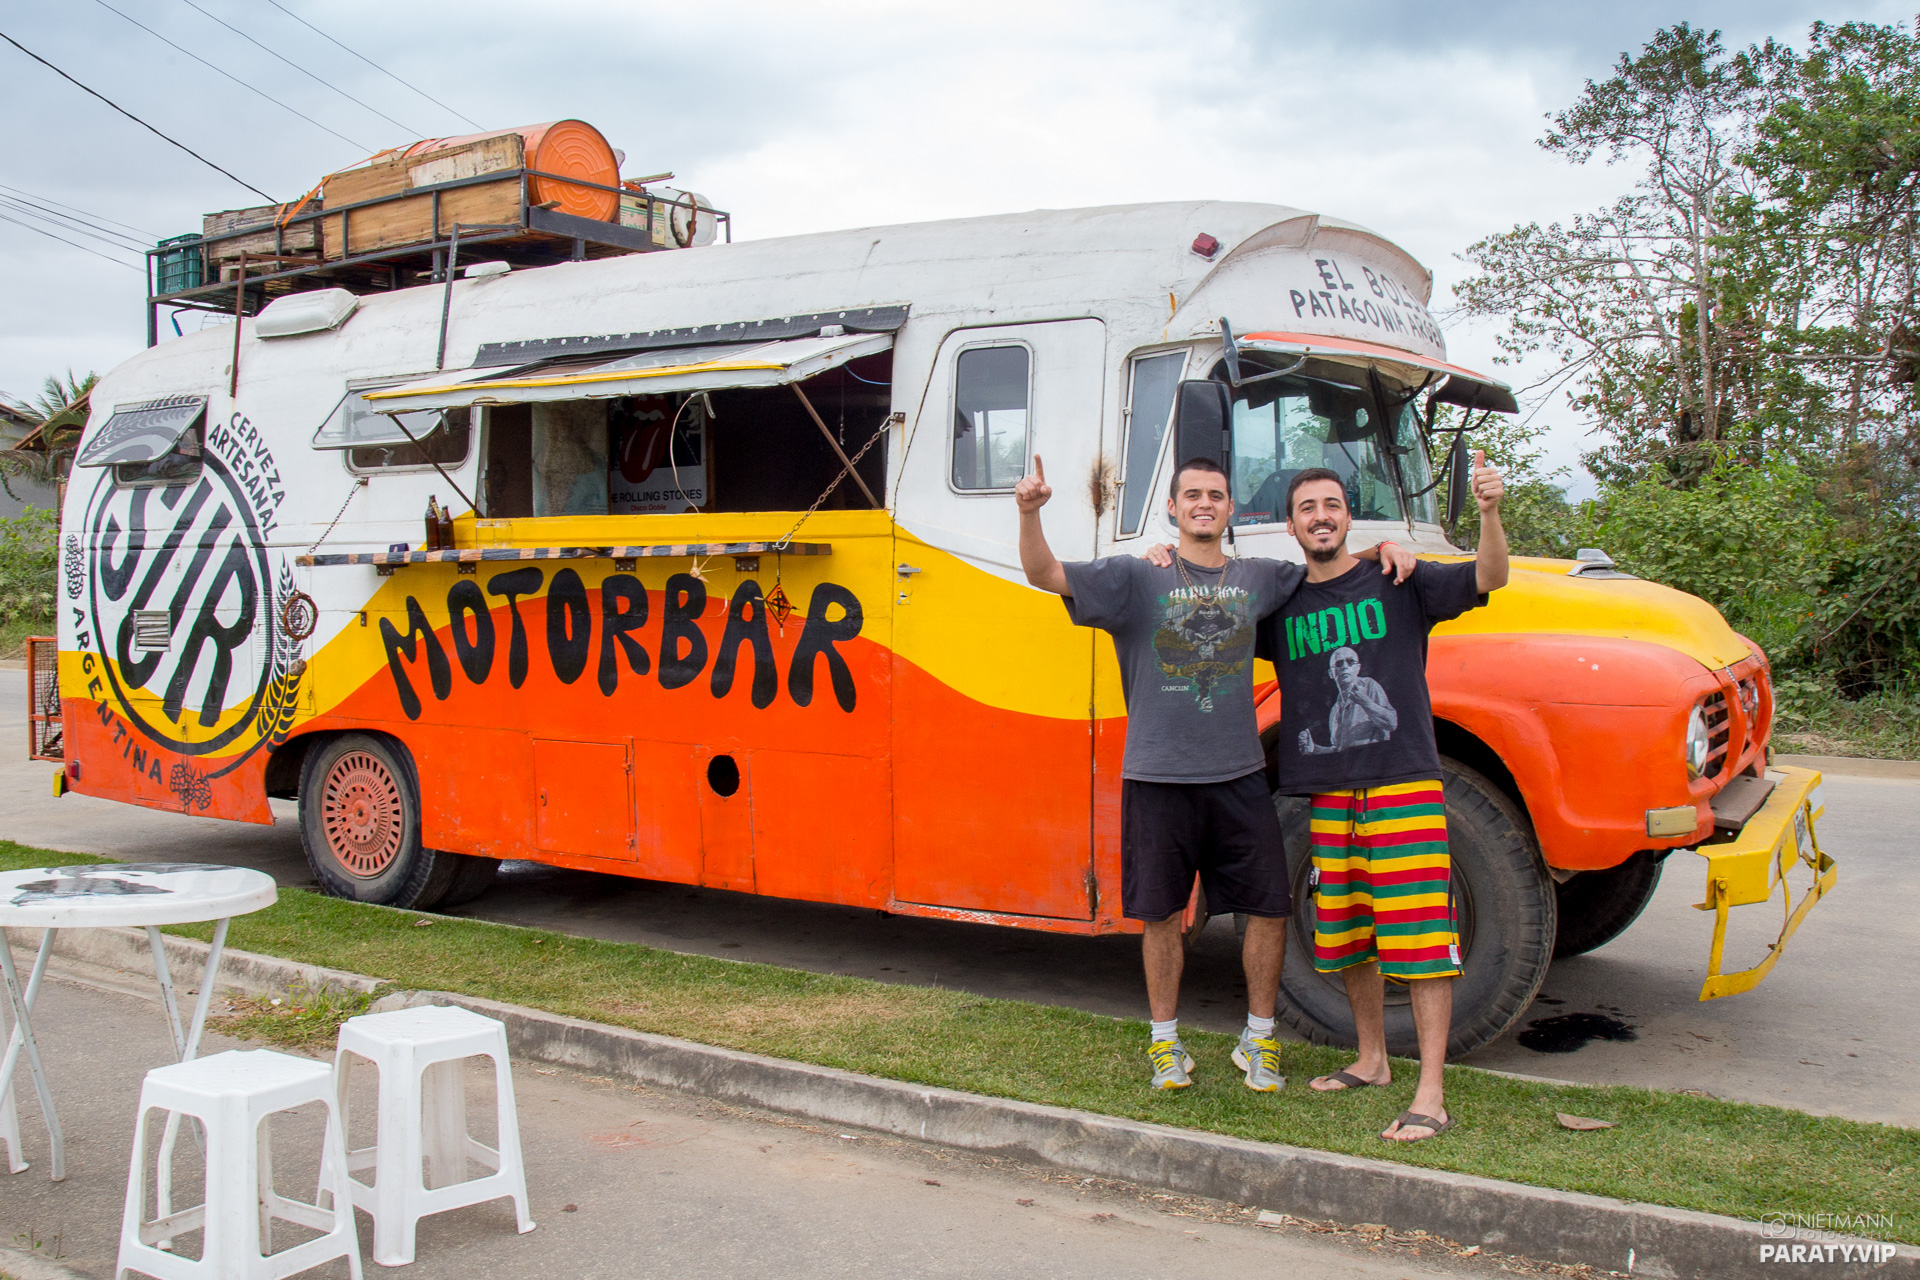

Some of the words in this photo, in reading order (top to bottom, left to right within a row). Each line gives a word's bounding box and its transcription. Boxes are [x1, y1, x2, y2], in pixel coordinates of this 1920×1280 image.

[1314, 258, 1354, 292] EL
[1289, 289, 1410, 336] PATAGONIA
[208, 423, 279, 542] ARTESANAL
[230, 411, 286, 509] CERVEZA
[619, 491, 661, 503] ROLLING
[662, 488, 703, 501] STONES
[630, 504, 647, 512] Disco
[378, 567, 864, 722] MOTORBAR
[1285, 597, 1387, 661] INDIO
[72, 606, 163, 785] ARGENTINA
